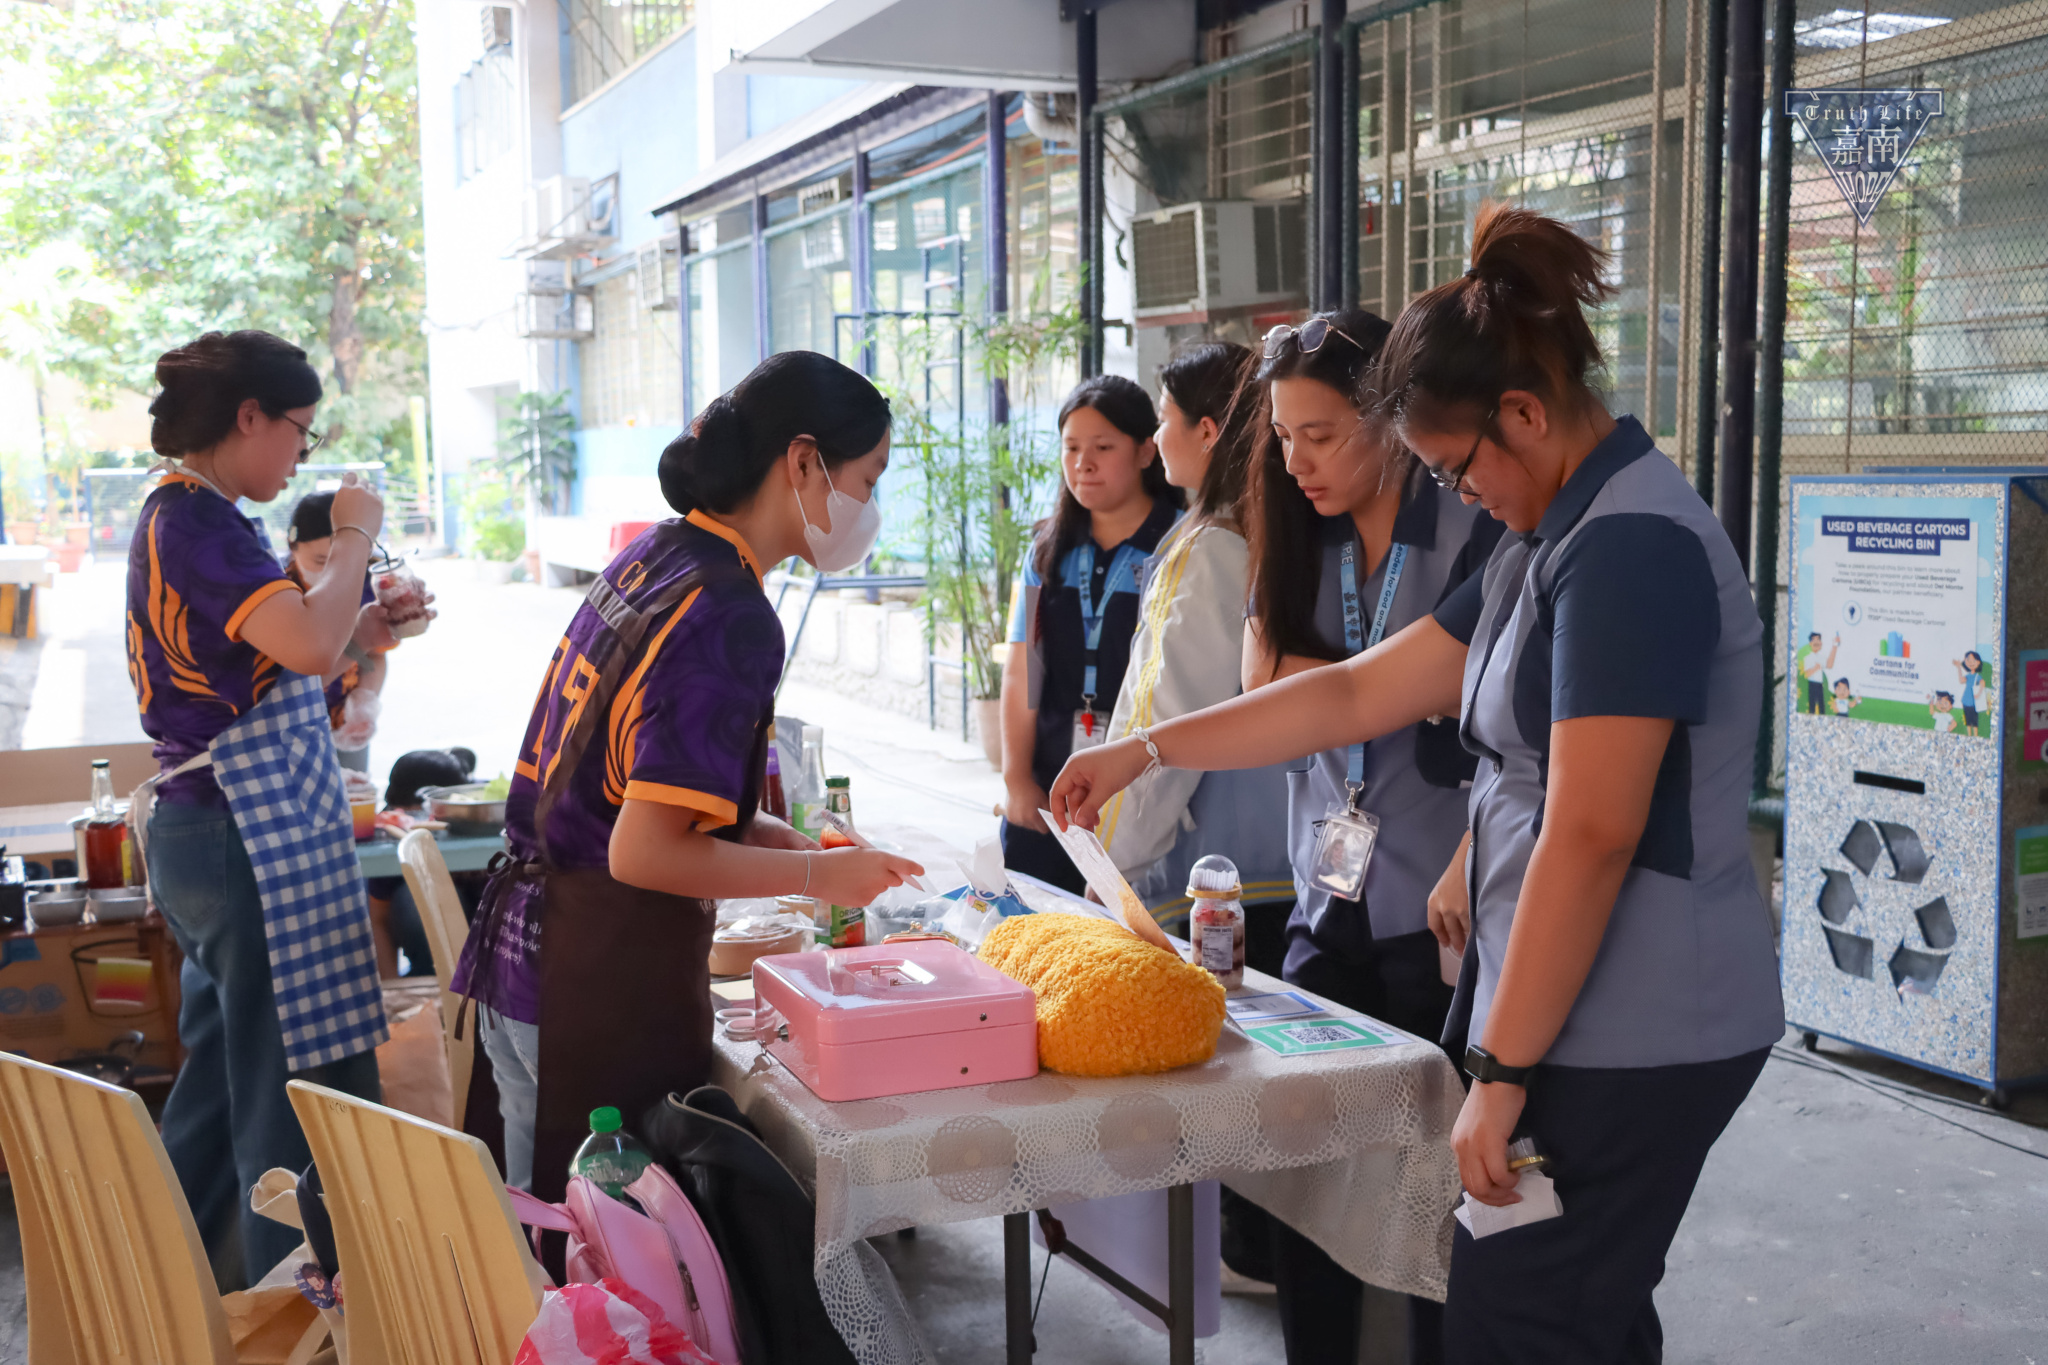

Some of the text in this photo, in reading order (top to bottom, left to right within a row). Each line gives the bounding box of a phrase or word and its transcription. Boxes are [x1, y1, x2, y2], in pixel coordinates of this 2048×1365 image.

[1826, 521, 1966, 536] USED BEVERAGE CARTONS
[1855, 536, 1935, 550] RECYCLING BIN
[1387, 576, 1395, 588] for
[1381, 590, 1391, 608] God
[1377, 610, 1385, 627] and
[1873, 658, 1916, 670] Cartons for
[1870, 667, 1919, 680] Communities
